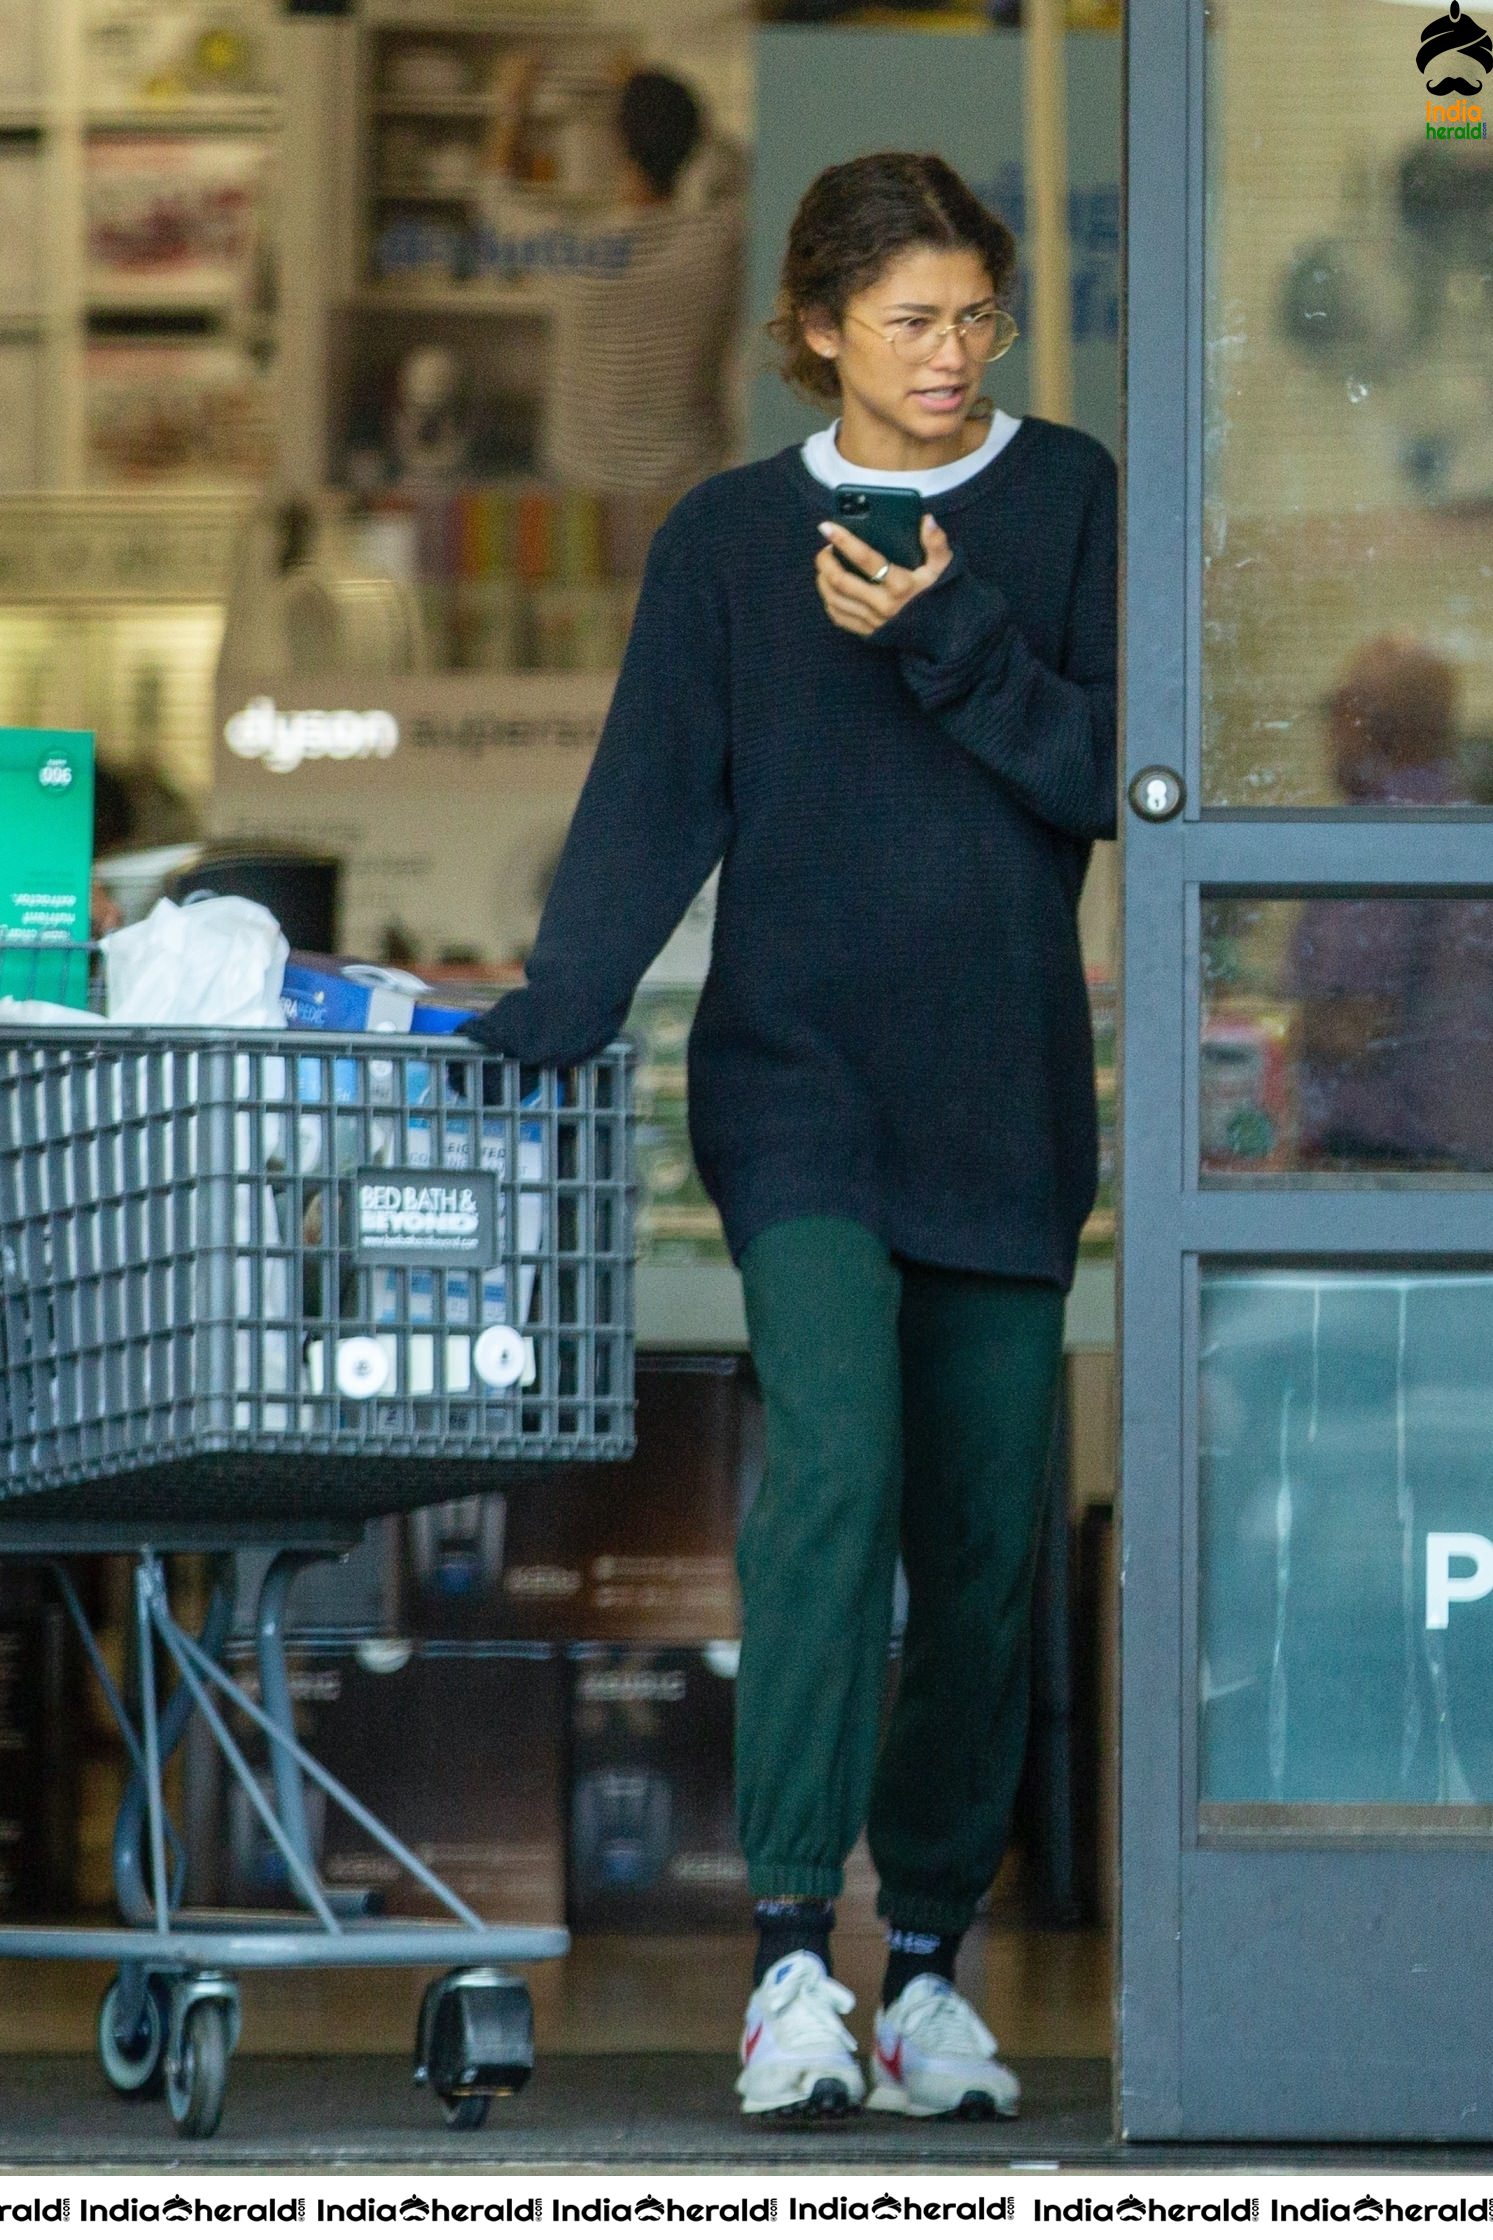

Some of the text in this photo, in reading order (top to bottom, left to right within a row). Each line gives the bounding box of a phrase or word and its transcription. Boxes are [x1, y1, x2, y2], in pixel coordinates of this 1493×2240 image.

[224, 697, 398, 773] dyson
[360, 1185, 477, 1213] BED BATH &
